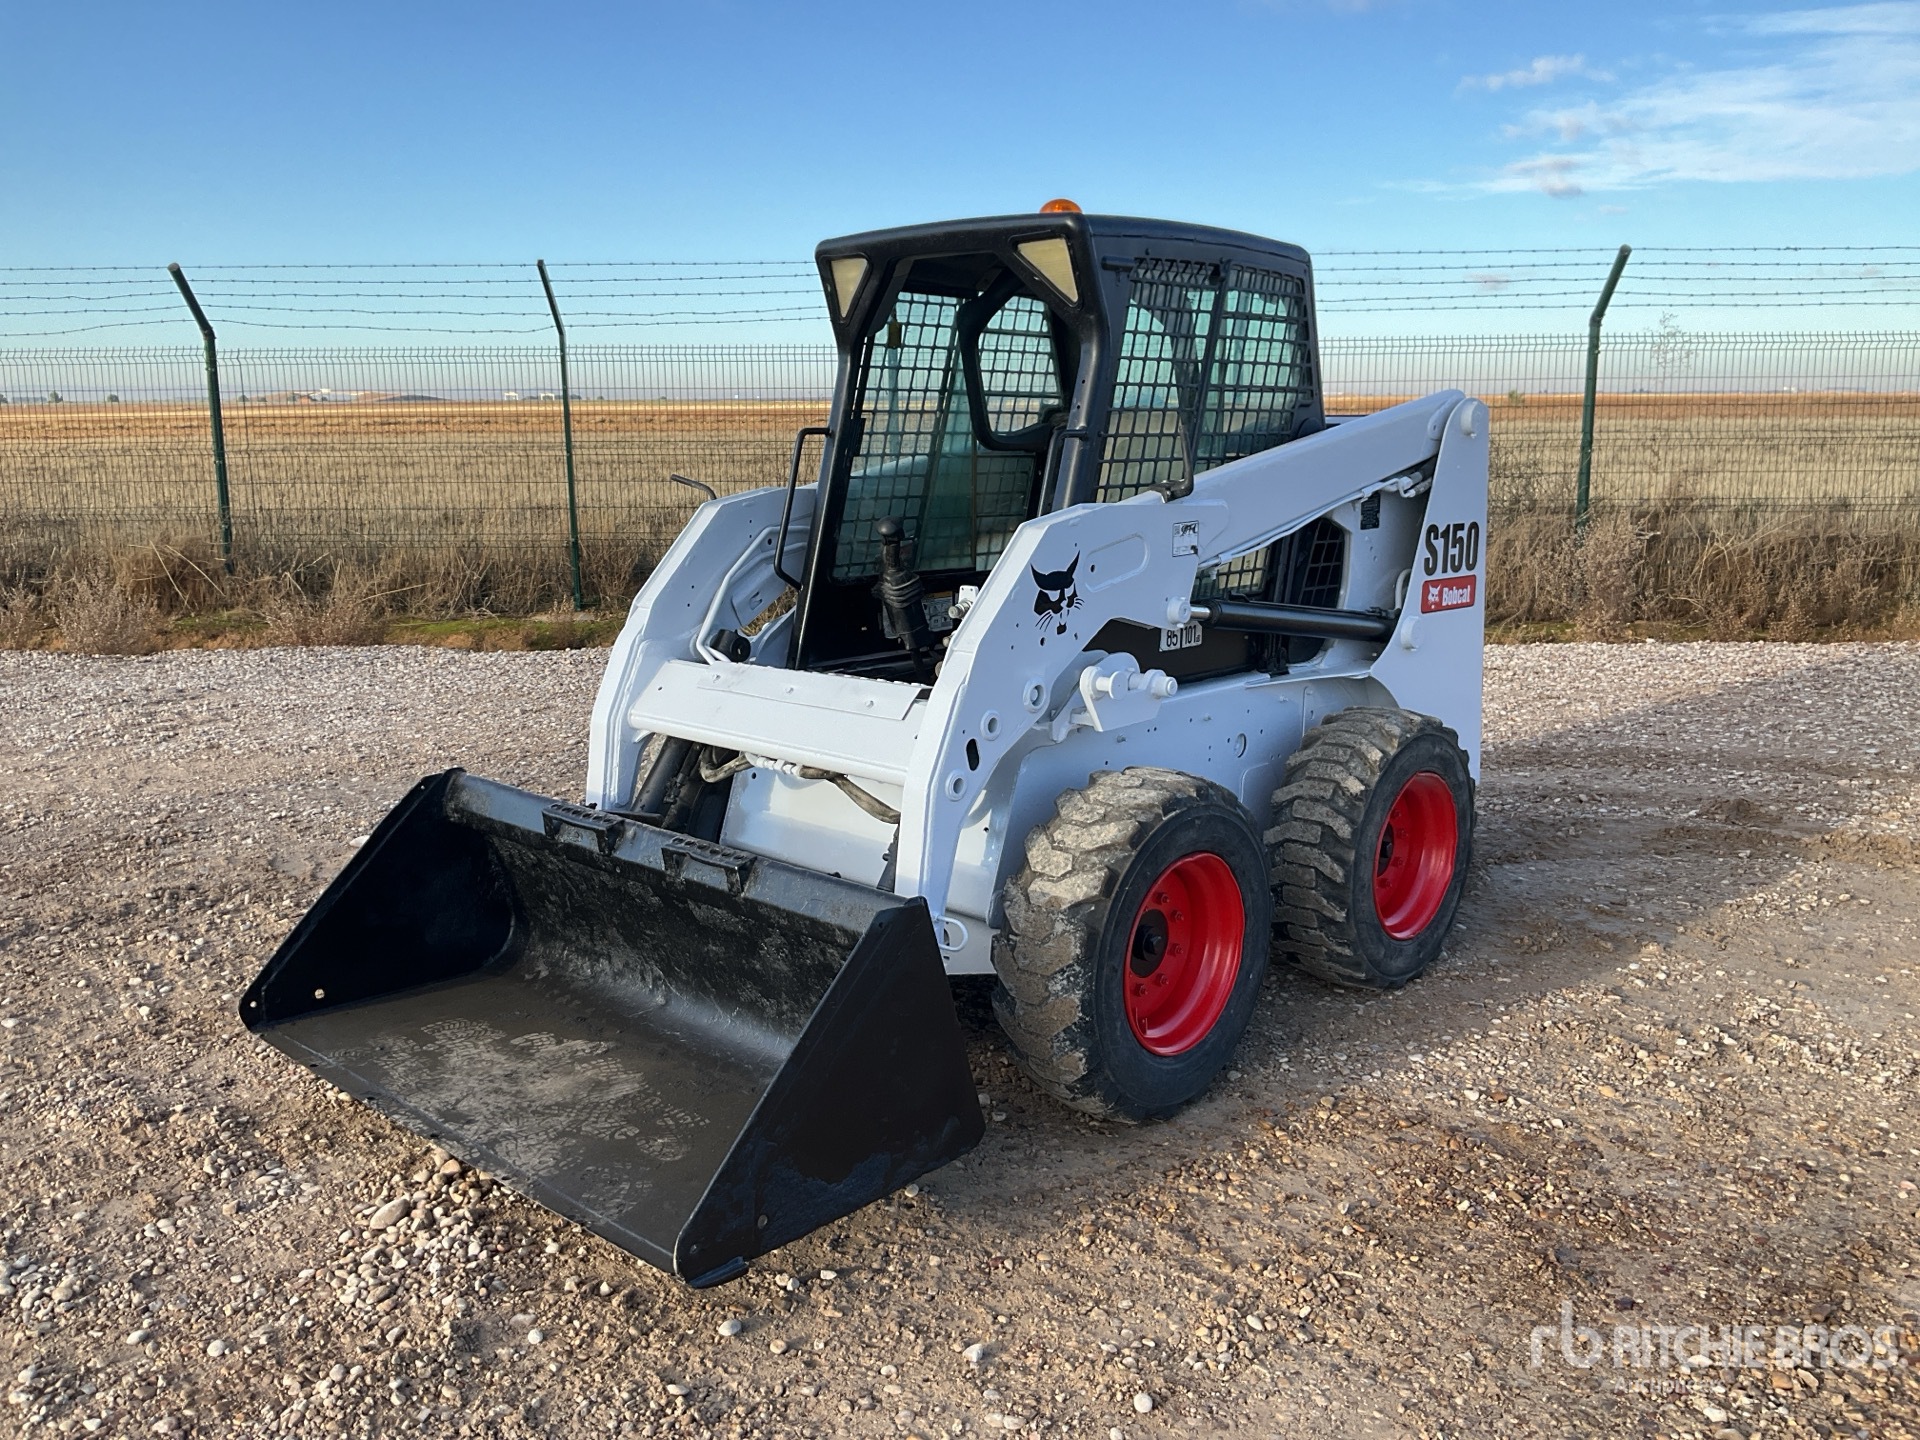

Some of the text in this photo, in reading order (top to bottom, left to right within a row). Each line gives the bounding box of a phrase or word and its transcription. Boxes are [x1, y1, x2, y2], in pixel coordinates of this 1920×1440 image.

[1424, 522, 1479, 576] S150
[1442, 585, 1470, 606] Bobcat
[1166, 629, 1178, 647] 85
